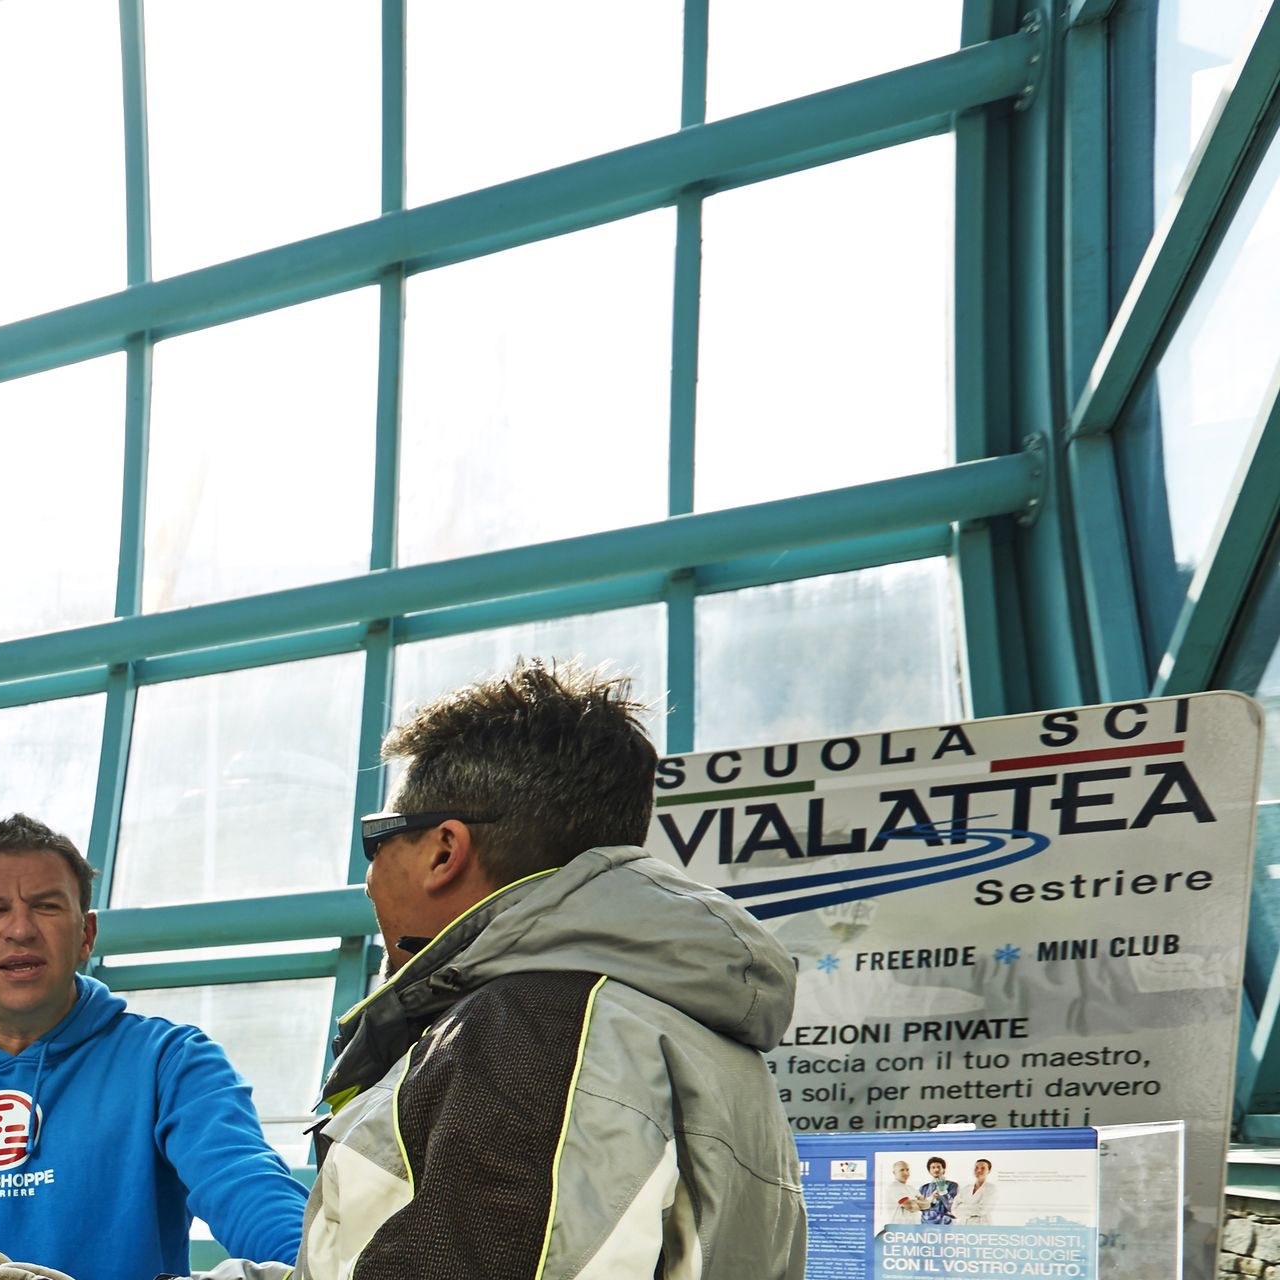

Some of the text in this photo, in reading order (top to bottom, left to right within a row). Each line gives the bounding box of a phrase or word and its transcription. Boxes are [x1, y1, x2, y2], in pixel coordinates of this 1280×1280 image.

[656, 698, 1190, 789] SCUOLA SCI
[657, 761, 1217, 868] VIALATTEA
[974, 868, 1214, 906] Sestriere
[856, 932, 1181, 972] FREERIDE MINI CLUB
[778, 1018, 1029, 1047] LEZIONI PRIVATE
[787, 1054, 865, 1075] faccia
[876, 1056, 924, 1072] con
[937, 1050, 953, 1070] il
[964, 1052, 1010, 1071] tuo
[1021, 1047, 1151, 1070] maestro,
[801, 1082, 855, 1105] soli,
[867, 1084, 910, 1105] per
[920, 1078, 1033, 1101] metterti
[1044, 1075, 1161, 1099] davvero
[848, 1115, 864, 1131] e
[875, 1111, 997, 1131] imparare
[1008, 1109, 1070, 1128] tutti
[1083, 1108, 1090, 1127] i
[882, 1231, 941, 1244] GRANDI
[944, 1233, 1086, 1249] PROFESSIONISTI.
[883, 1245, 902, 1257] LE
[904, 1246, 971, 1259] MIGLIORI
[882, 1259, 1086, 1277] CON IL VOSTRO AIUTO.
